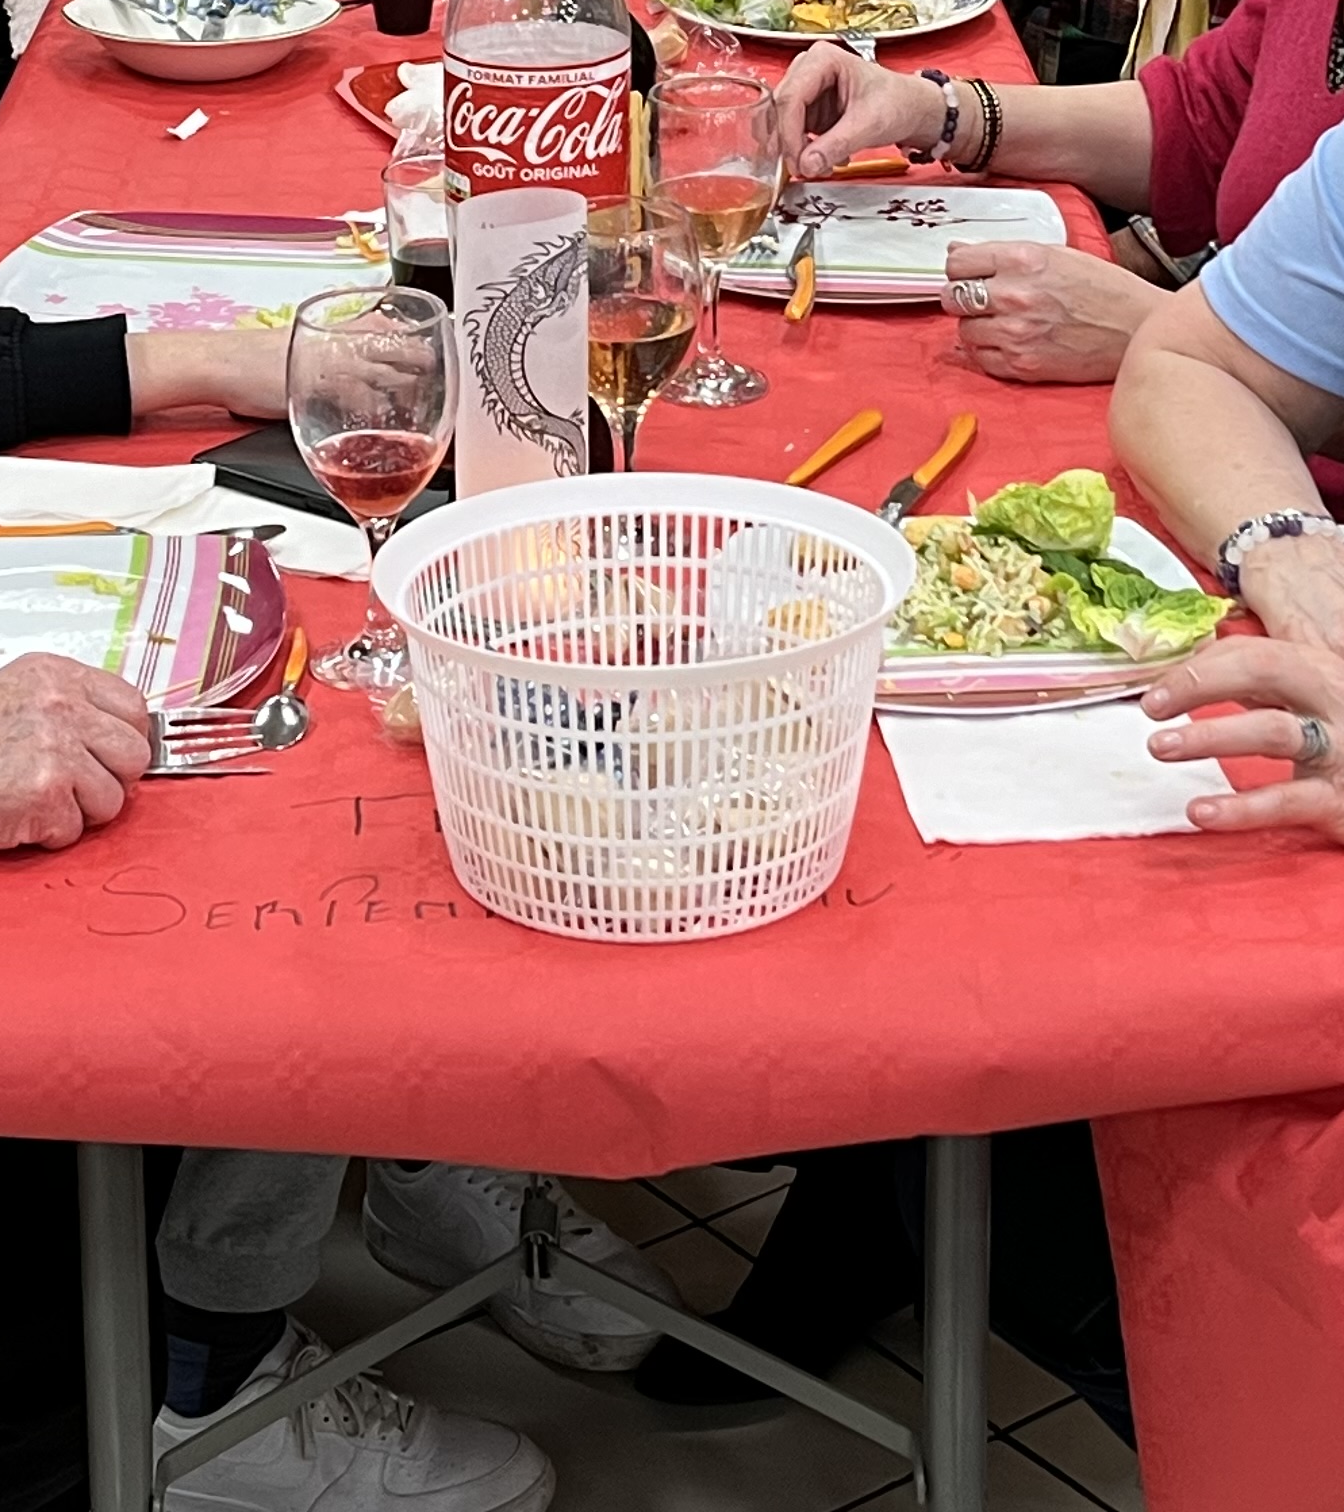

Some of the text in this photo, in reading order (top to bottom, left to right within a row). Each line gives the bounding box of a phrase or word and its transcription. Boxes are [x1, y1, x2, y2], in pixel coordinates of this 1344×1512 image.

[467, 68, 596, 85] FORMAT FAMILIAL
[446, 76, 626, 165] Coca-Cola
[472, 162, 517, 179] GOÛT
[520, 163, 599, 181] ORIGINAL
